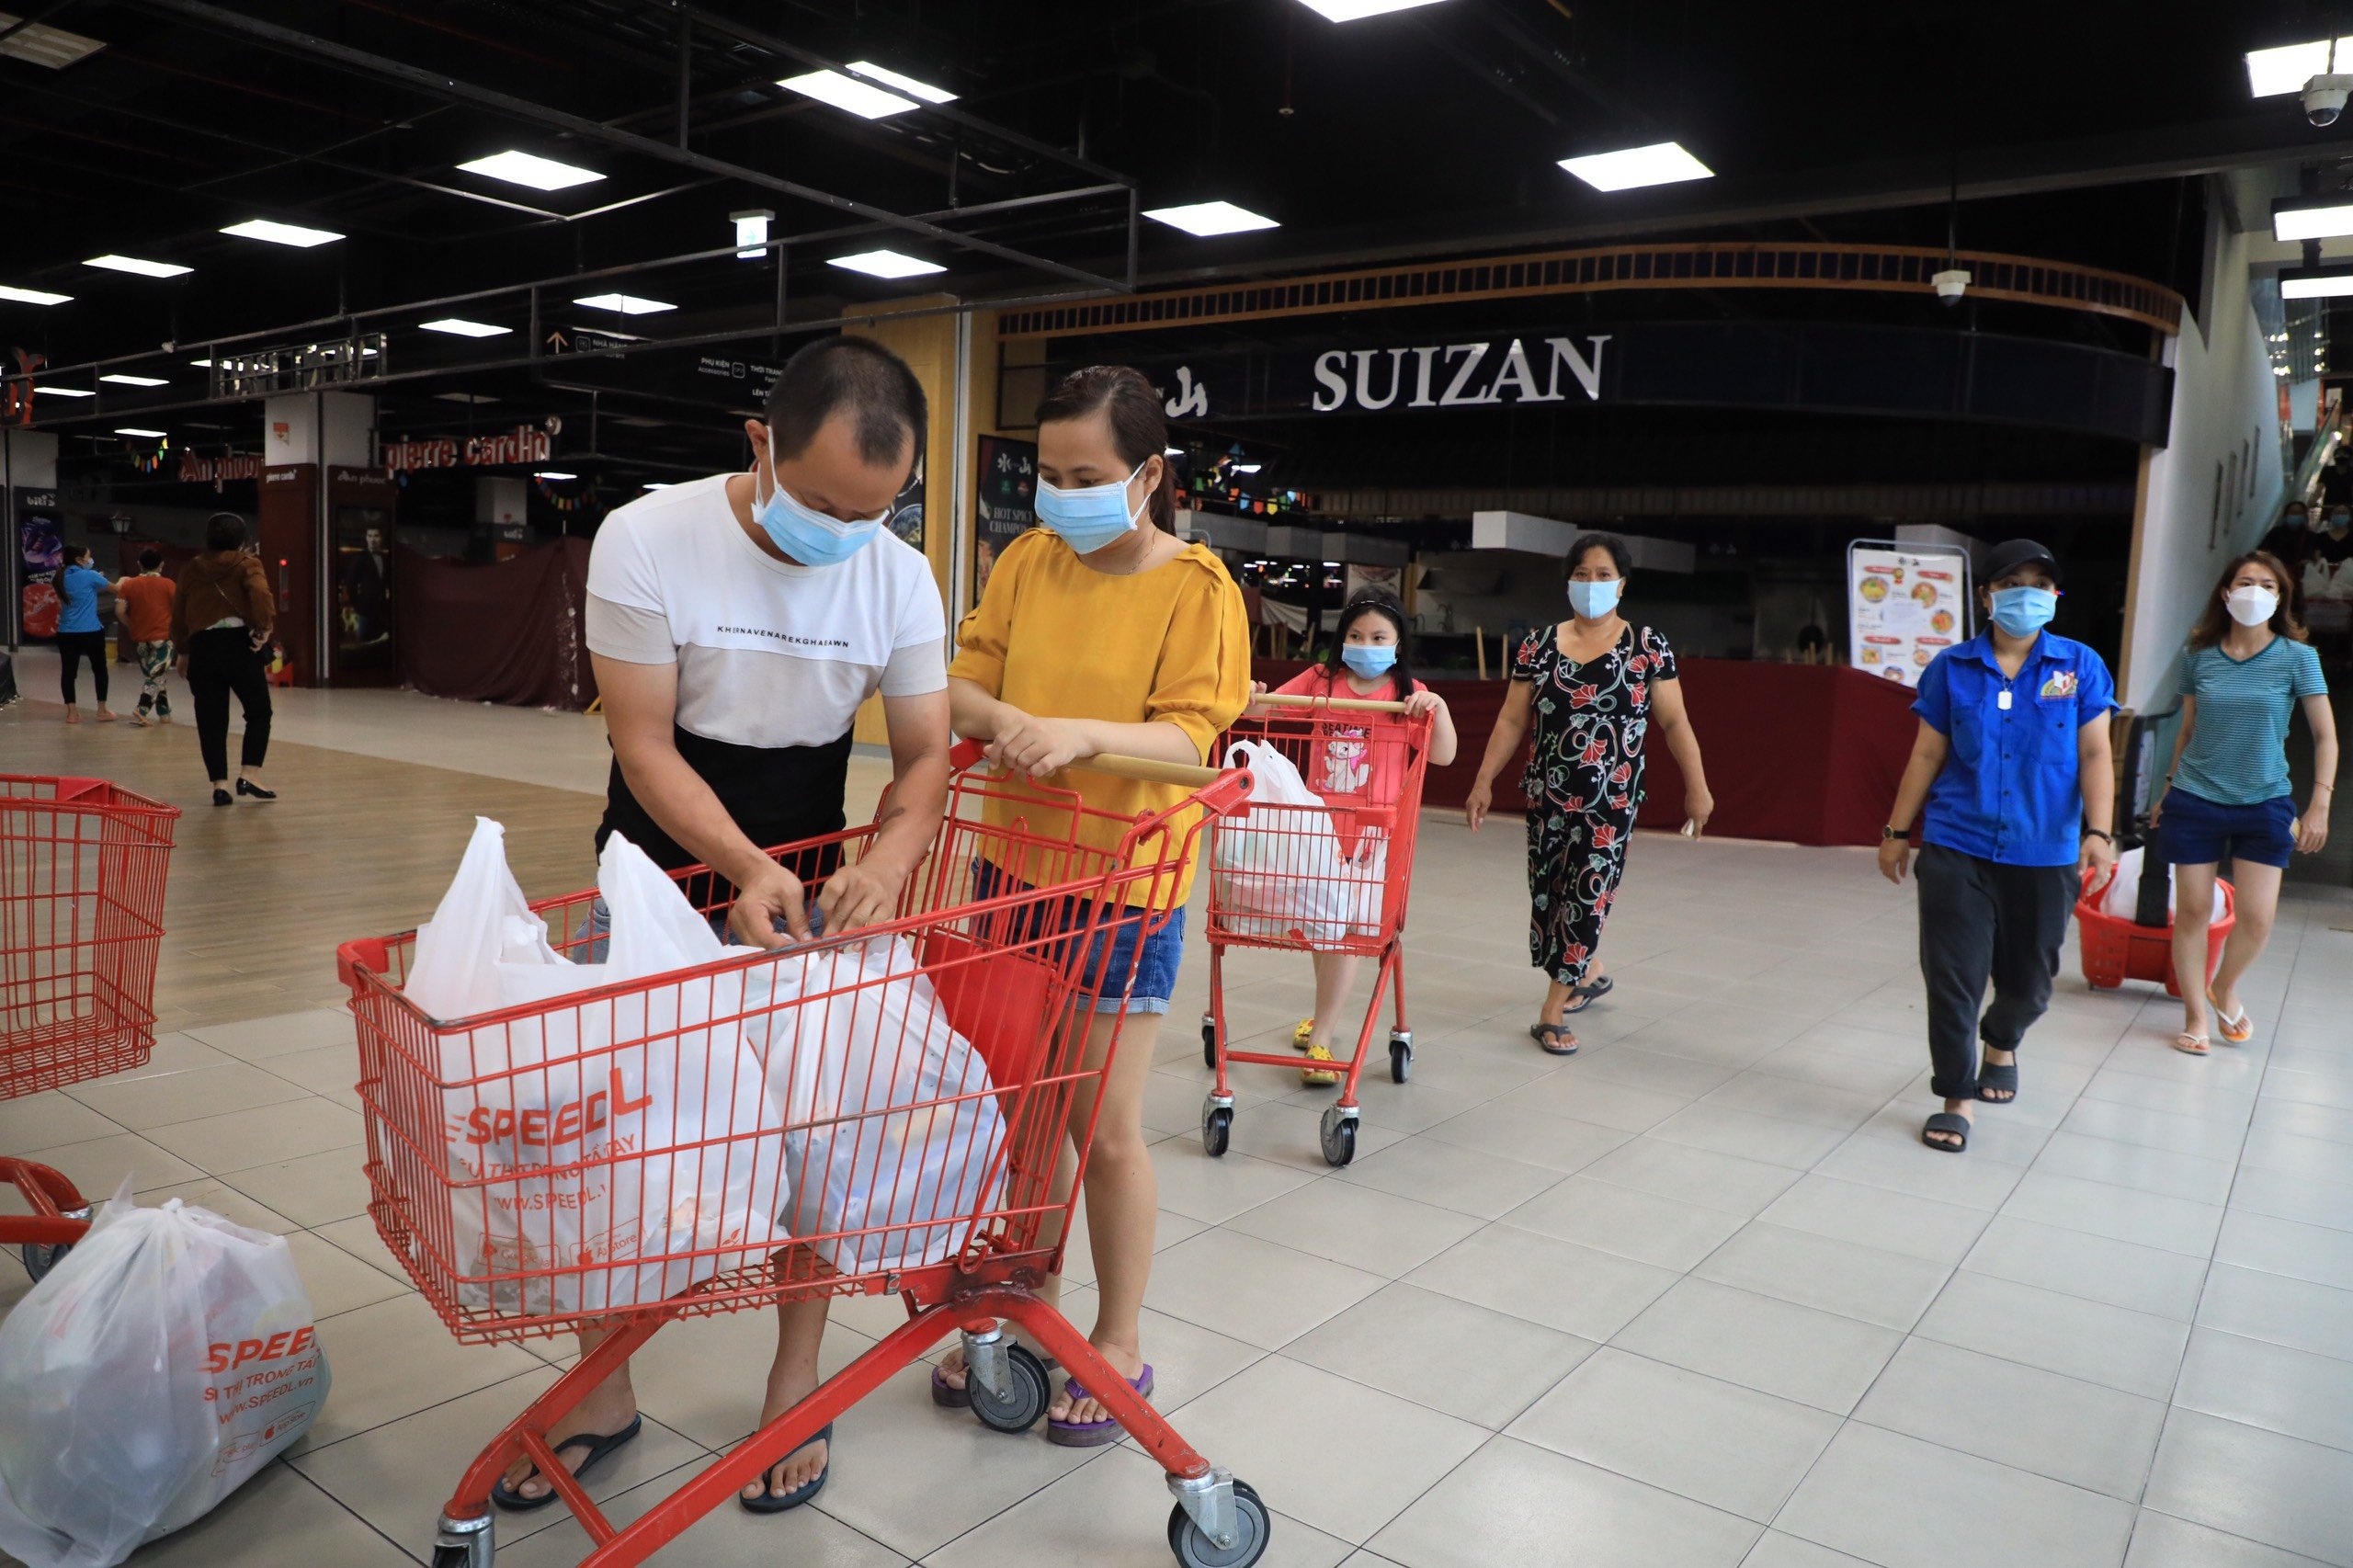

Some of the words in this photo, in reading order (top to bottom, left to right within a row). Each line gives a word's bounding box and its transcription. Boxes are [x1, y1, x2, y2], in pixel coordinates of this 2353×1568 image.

[1313, 335, 1612, 412] SUIZAN
[384, 434, 458, 481] pierre
[462, 424, 551, 466] cardin
[994, 507, 1011, 520] HOT
